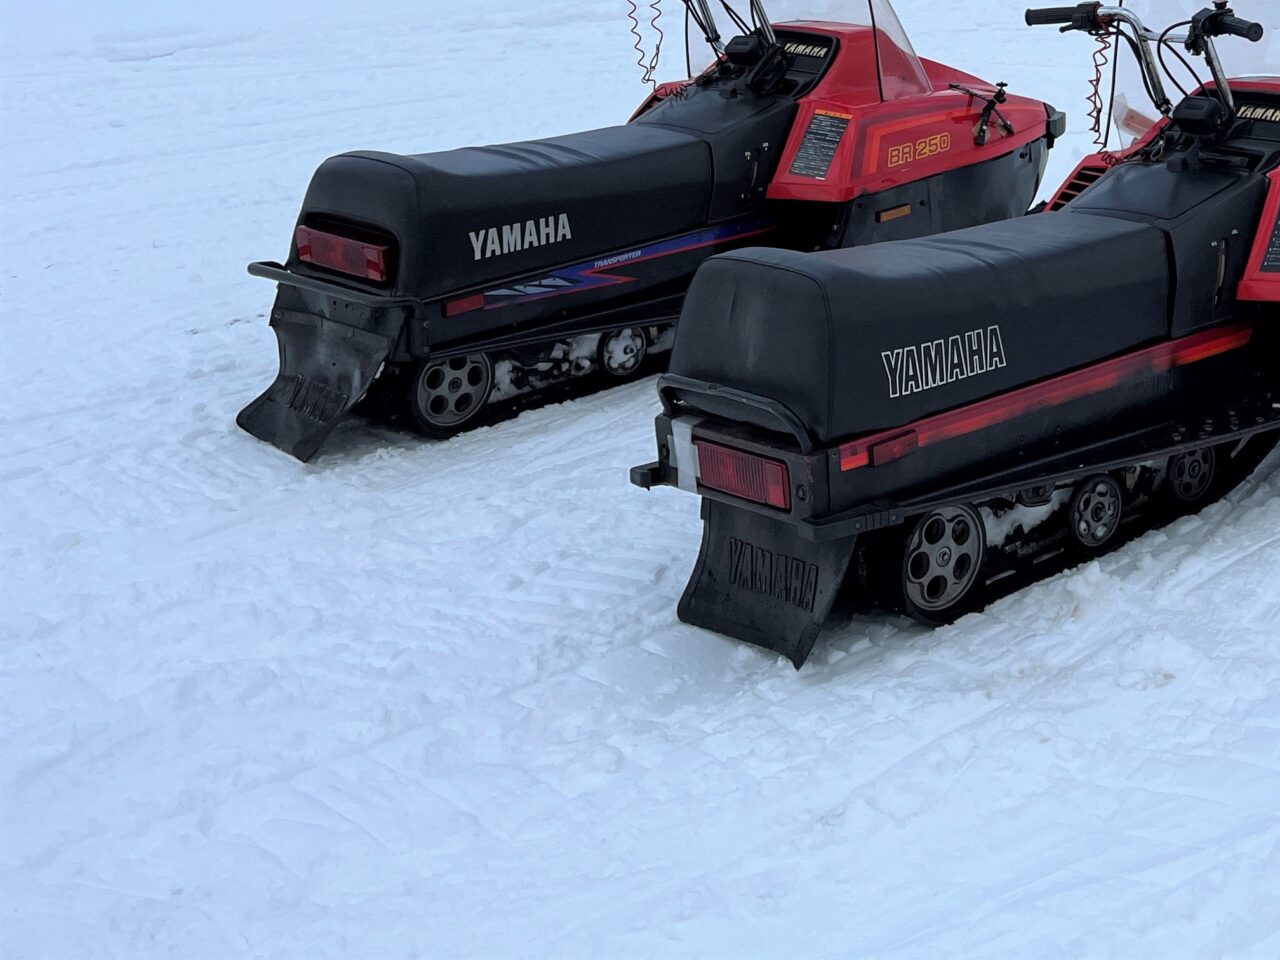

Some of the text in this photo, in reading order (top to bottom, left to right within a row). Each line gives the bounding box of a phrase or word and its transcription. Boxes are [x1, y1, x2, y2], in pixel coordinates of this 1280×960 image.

[784, 42, 828, 57] YAMAHA
[888, 132, 950, 167] BR 250
[469, 213, 572, 260] YAMAHA
[881, 325, 1007, 398] YAMAHA
[729, 536, 819, 613] YAMAHA
